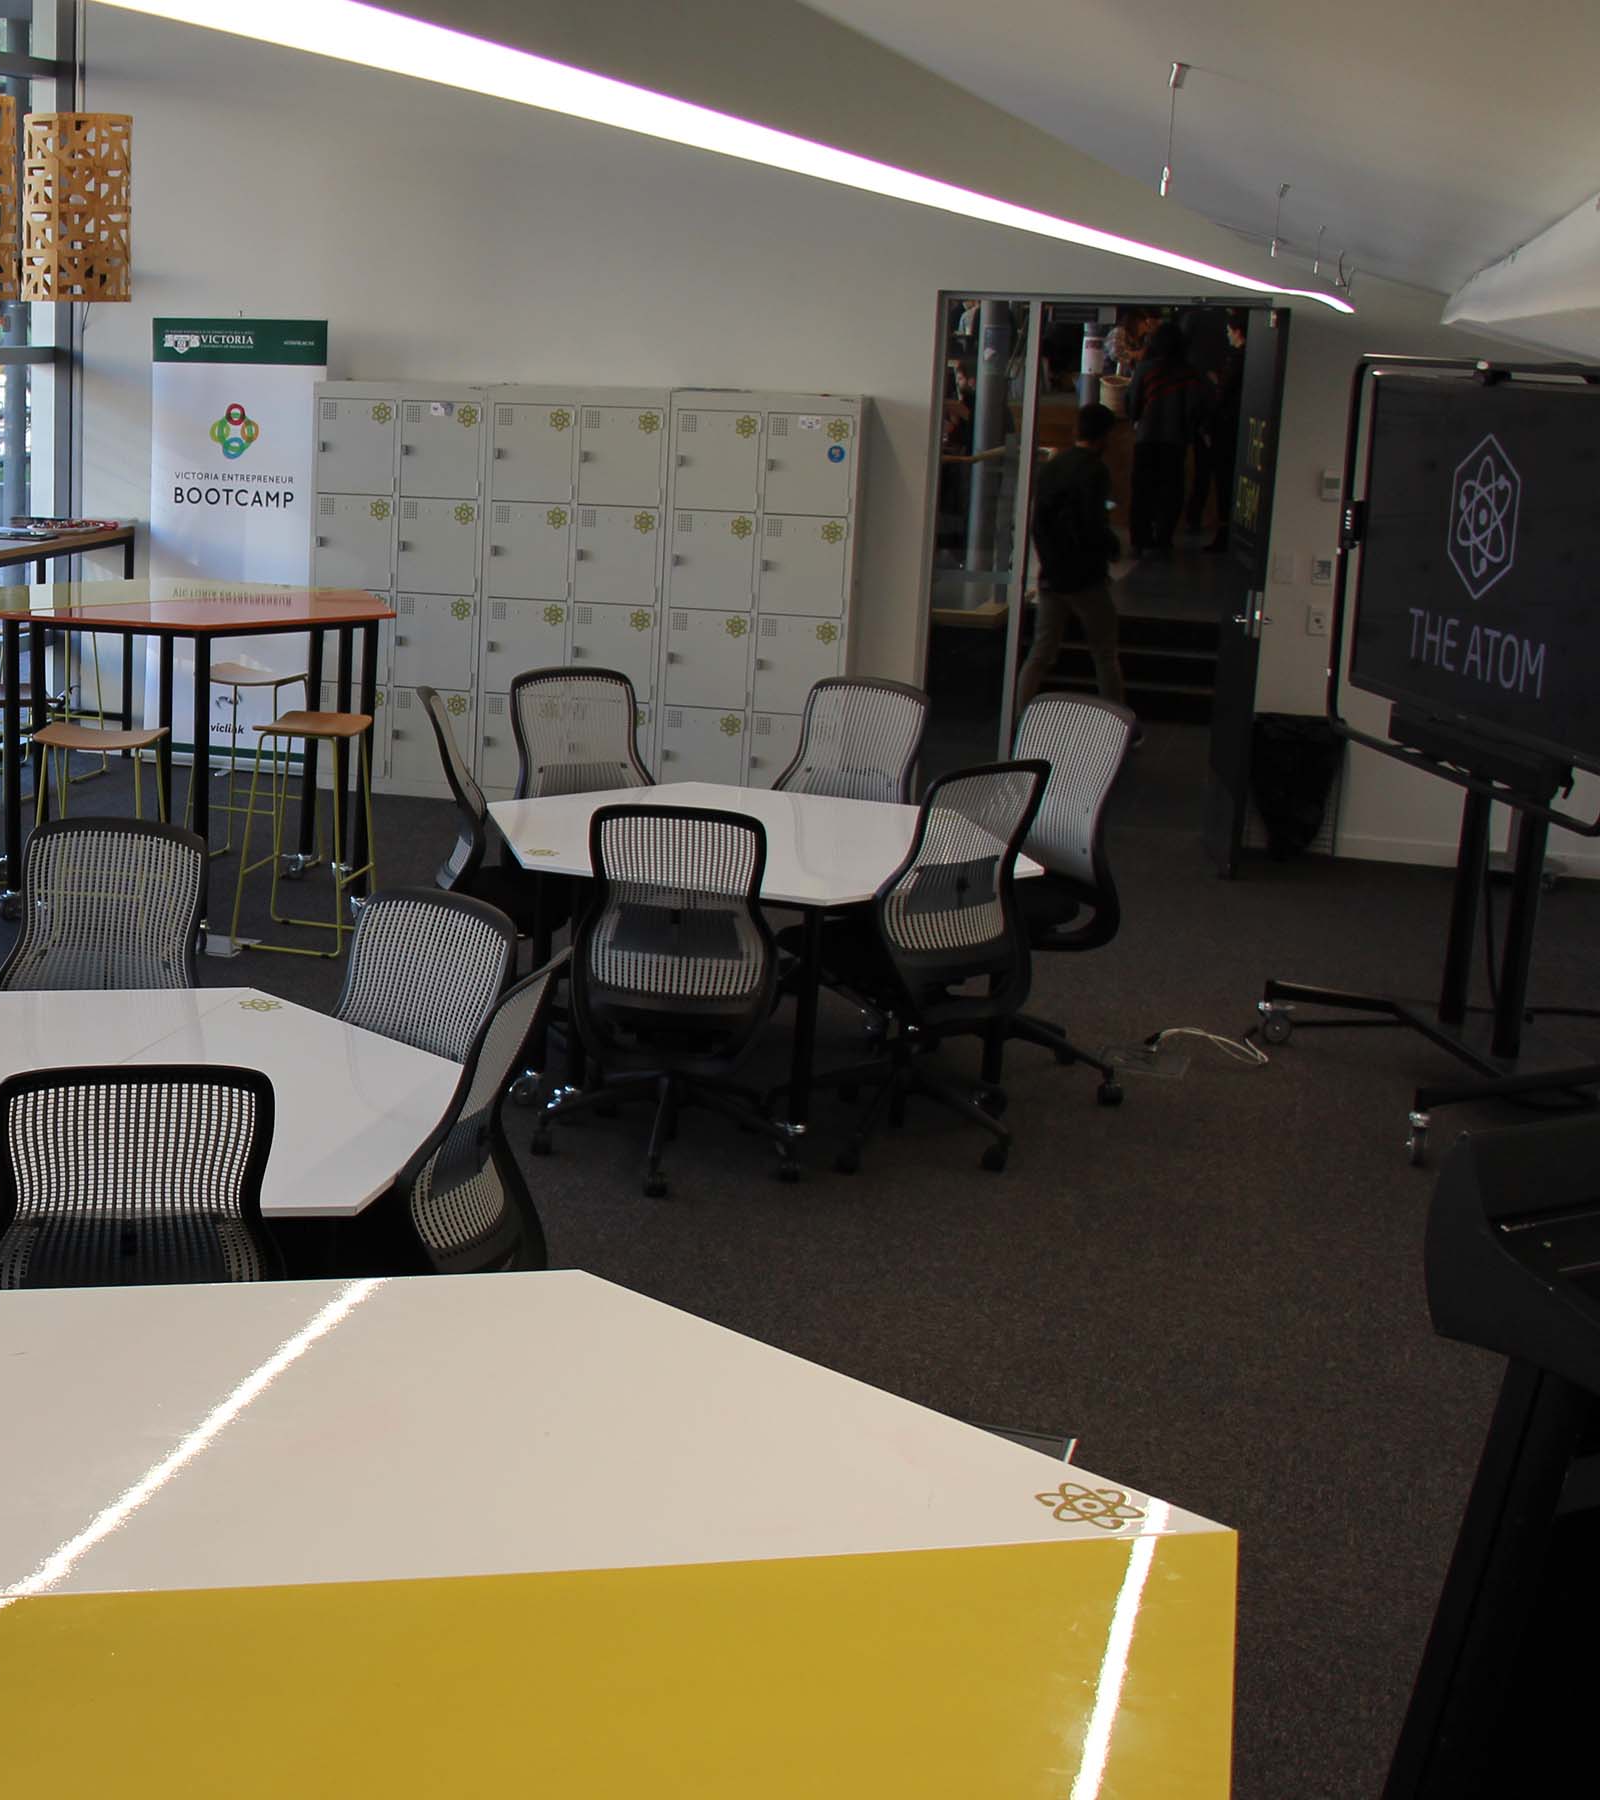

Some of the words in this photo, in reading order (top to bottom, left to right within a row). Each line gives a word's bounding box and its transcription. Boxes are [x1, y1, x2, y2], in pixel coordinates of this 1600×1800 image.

[201, 334, 254, 345] VICTORIA
[175, 471, 219, 481] VICTORIA
[222, 473, 294, 484] ENTREPRENEUR
[173, 486, 295, 509] BOOTCAMP
[1409, 607, 1460, 672] THE
[1463, 625, 1546, 699] ATOM
